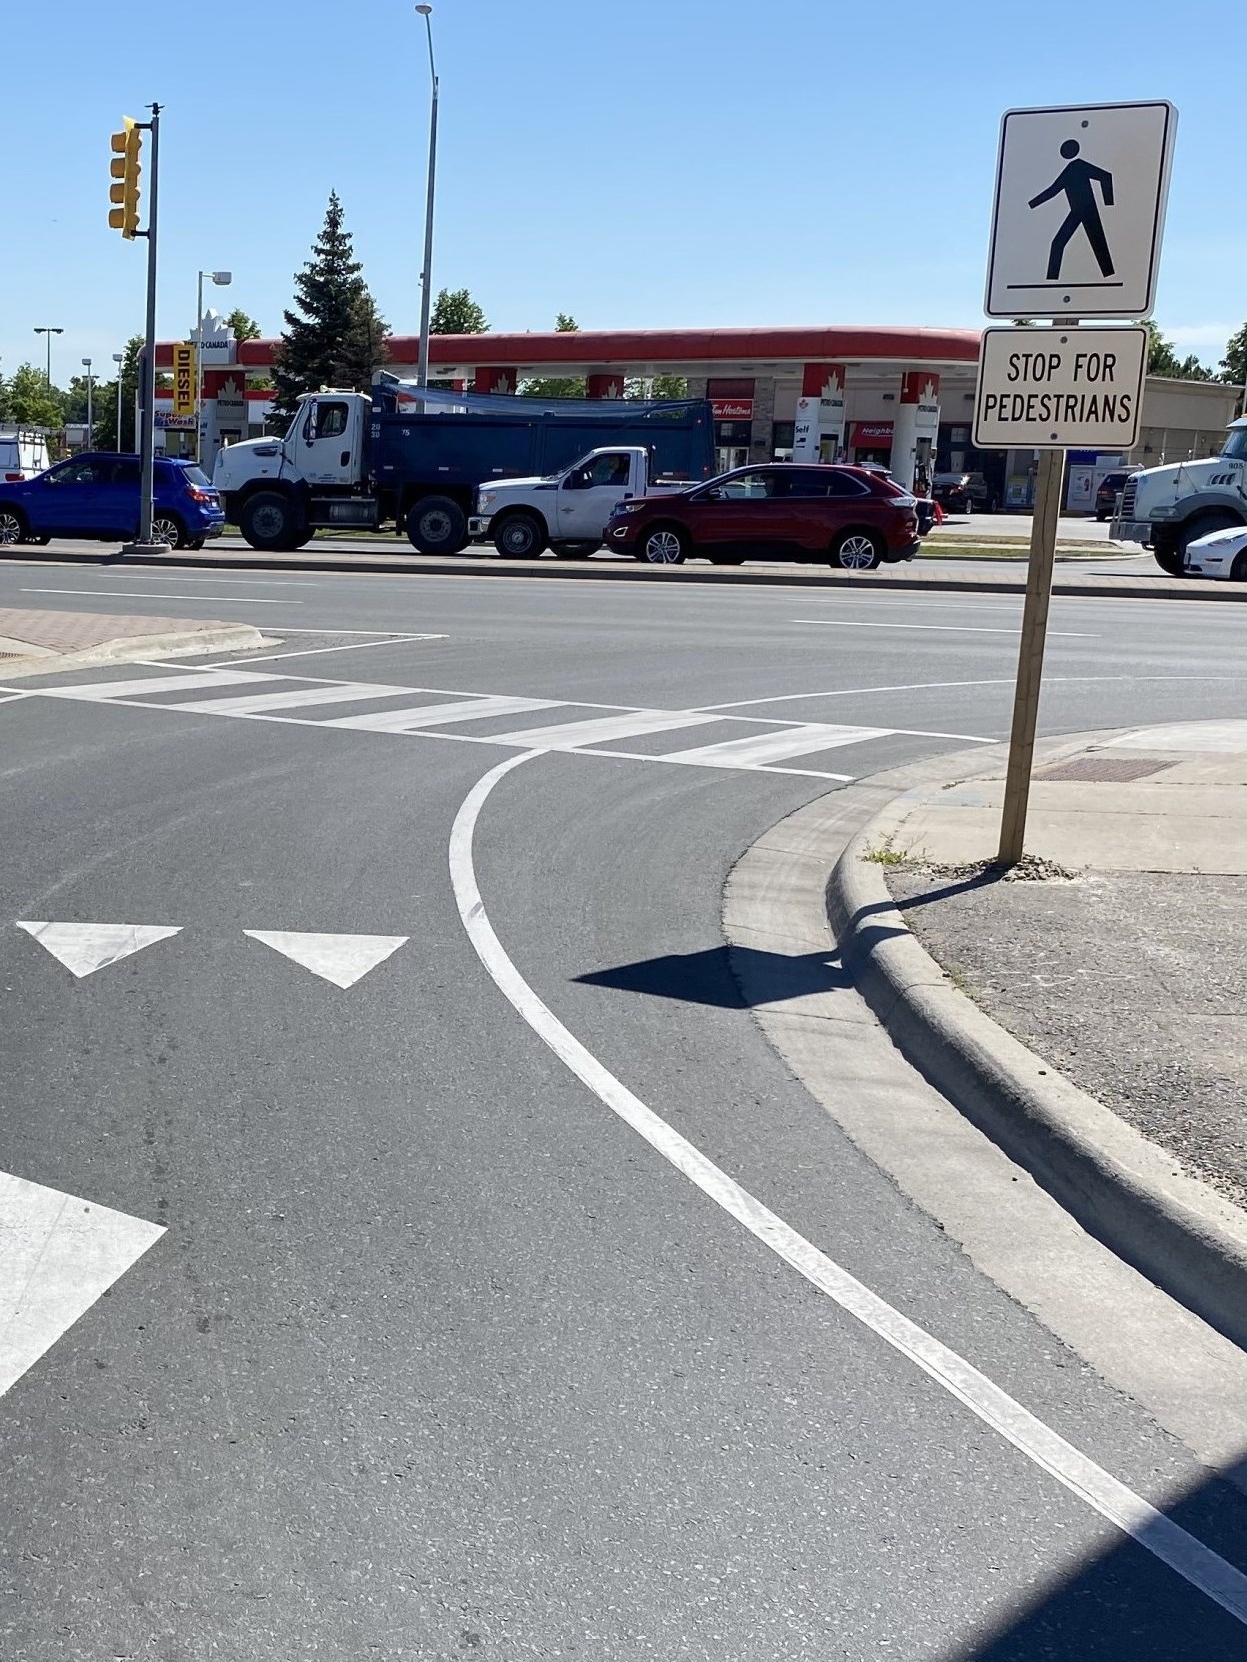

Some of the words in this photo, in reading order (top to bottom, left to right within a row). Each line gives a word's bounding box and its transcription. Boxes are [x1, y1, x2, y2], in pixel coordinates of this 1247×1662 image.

[178, 349, 190, 411] DIESEL
[1007, 353, 1061, 382] STOP
[1073, 353, 1116, 382] FOR
[983, 393, 1132, 423] PEDESTRIANS
[795, 425, 810, 433] Self
